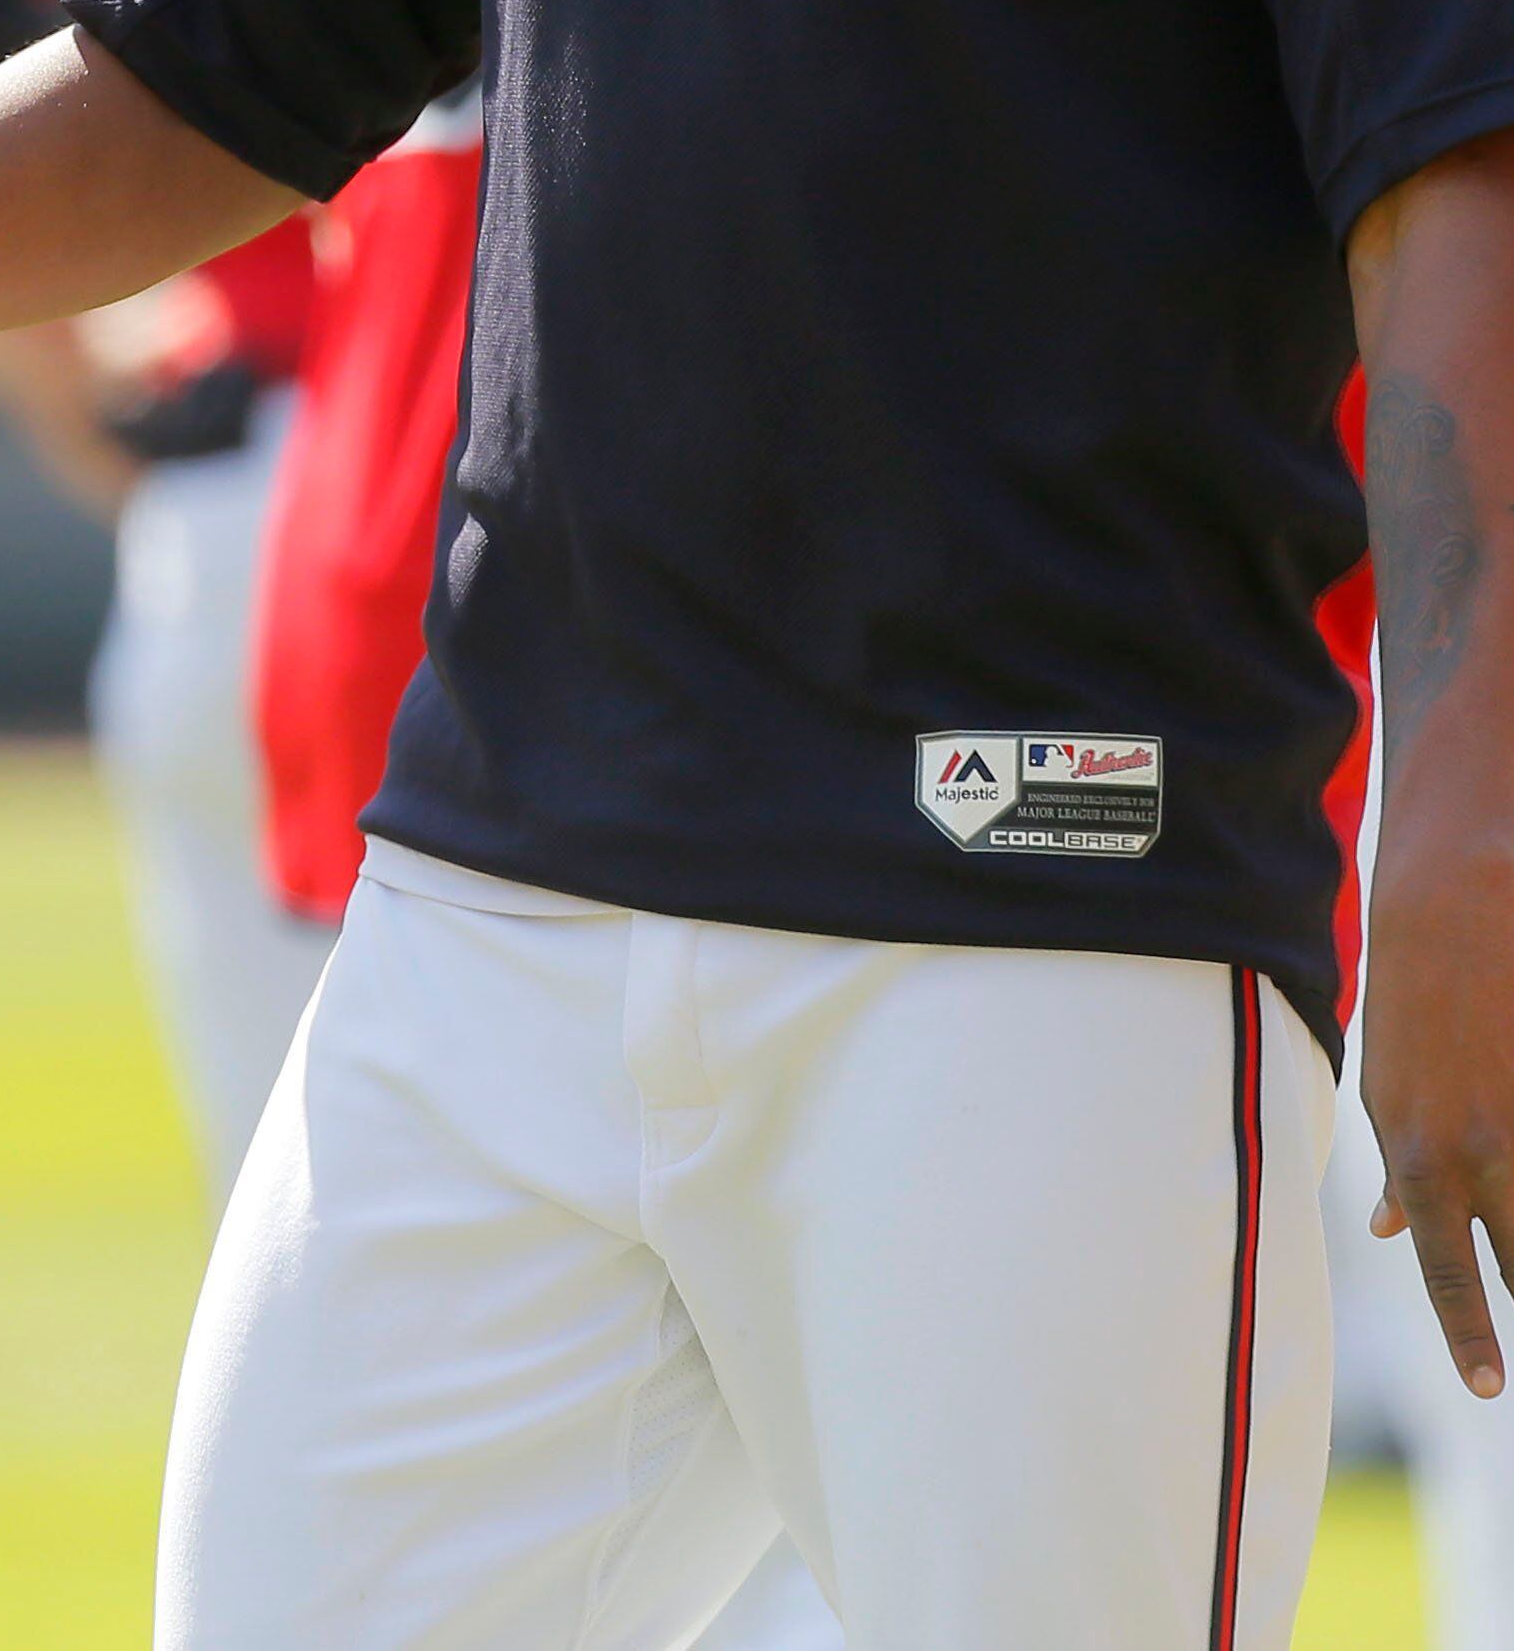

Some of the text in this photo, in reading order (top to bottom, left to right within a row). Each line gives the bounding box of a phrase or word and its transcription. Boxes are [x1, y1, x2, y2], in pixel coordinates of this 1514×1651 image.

[935, 786, 999, 805] Majestic
[1017, 807, 1056, 820] MAJOR
[1058, 807, 1101, 821] LEAGUE
